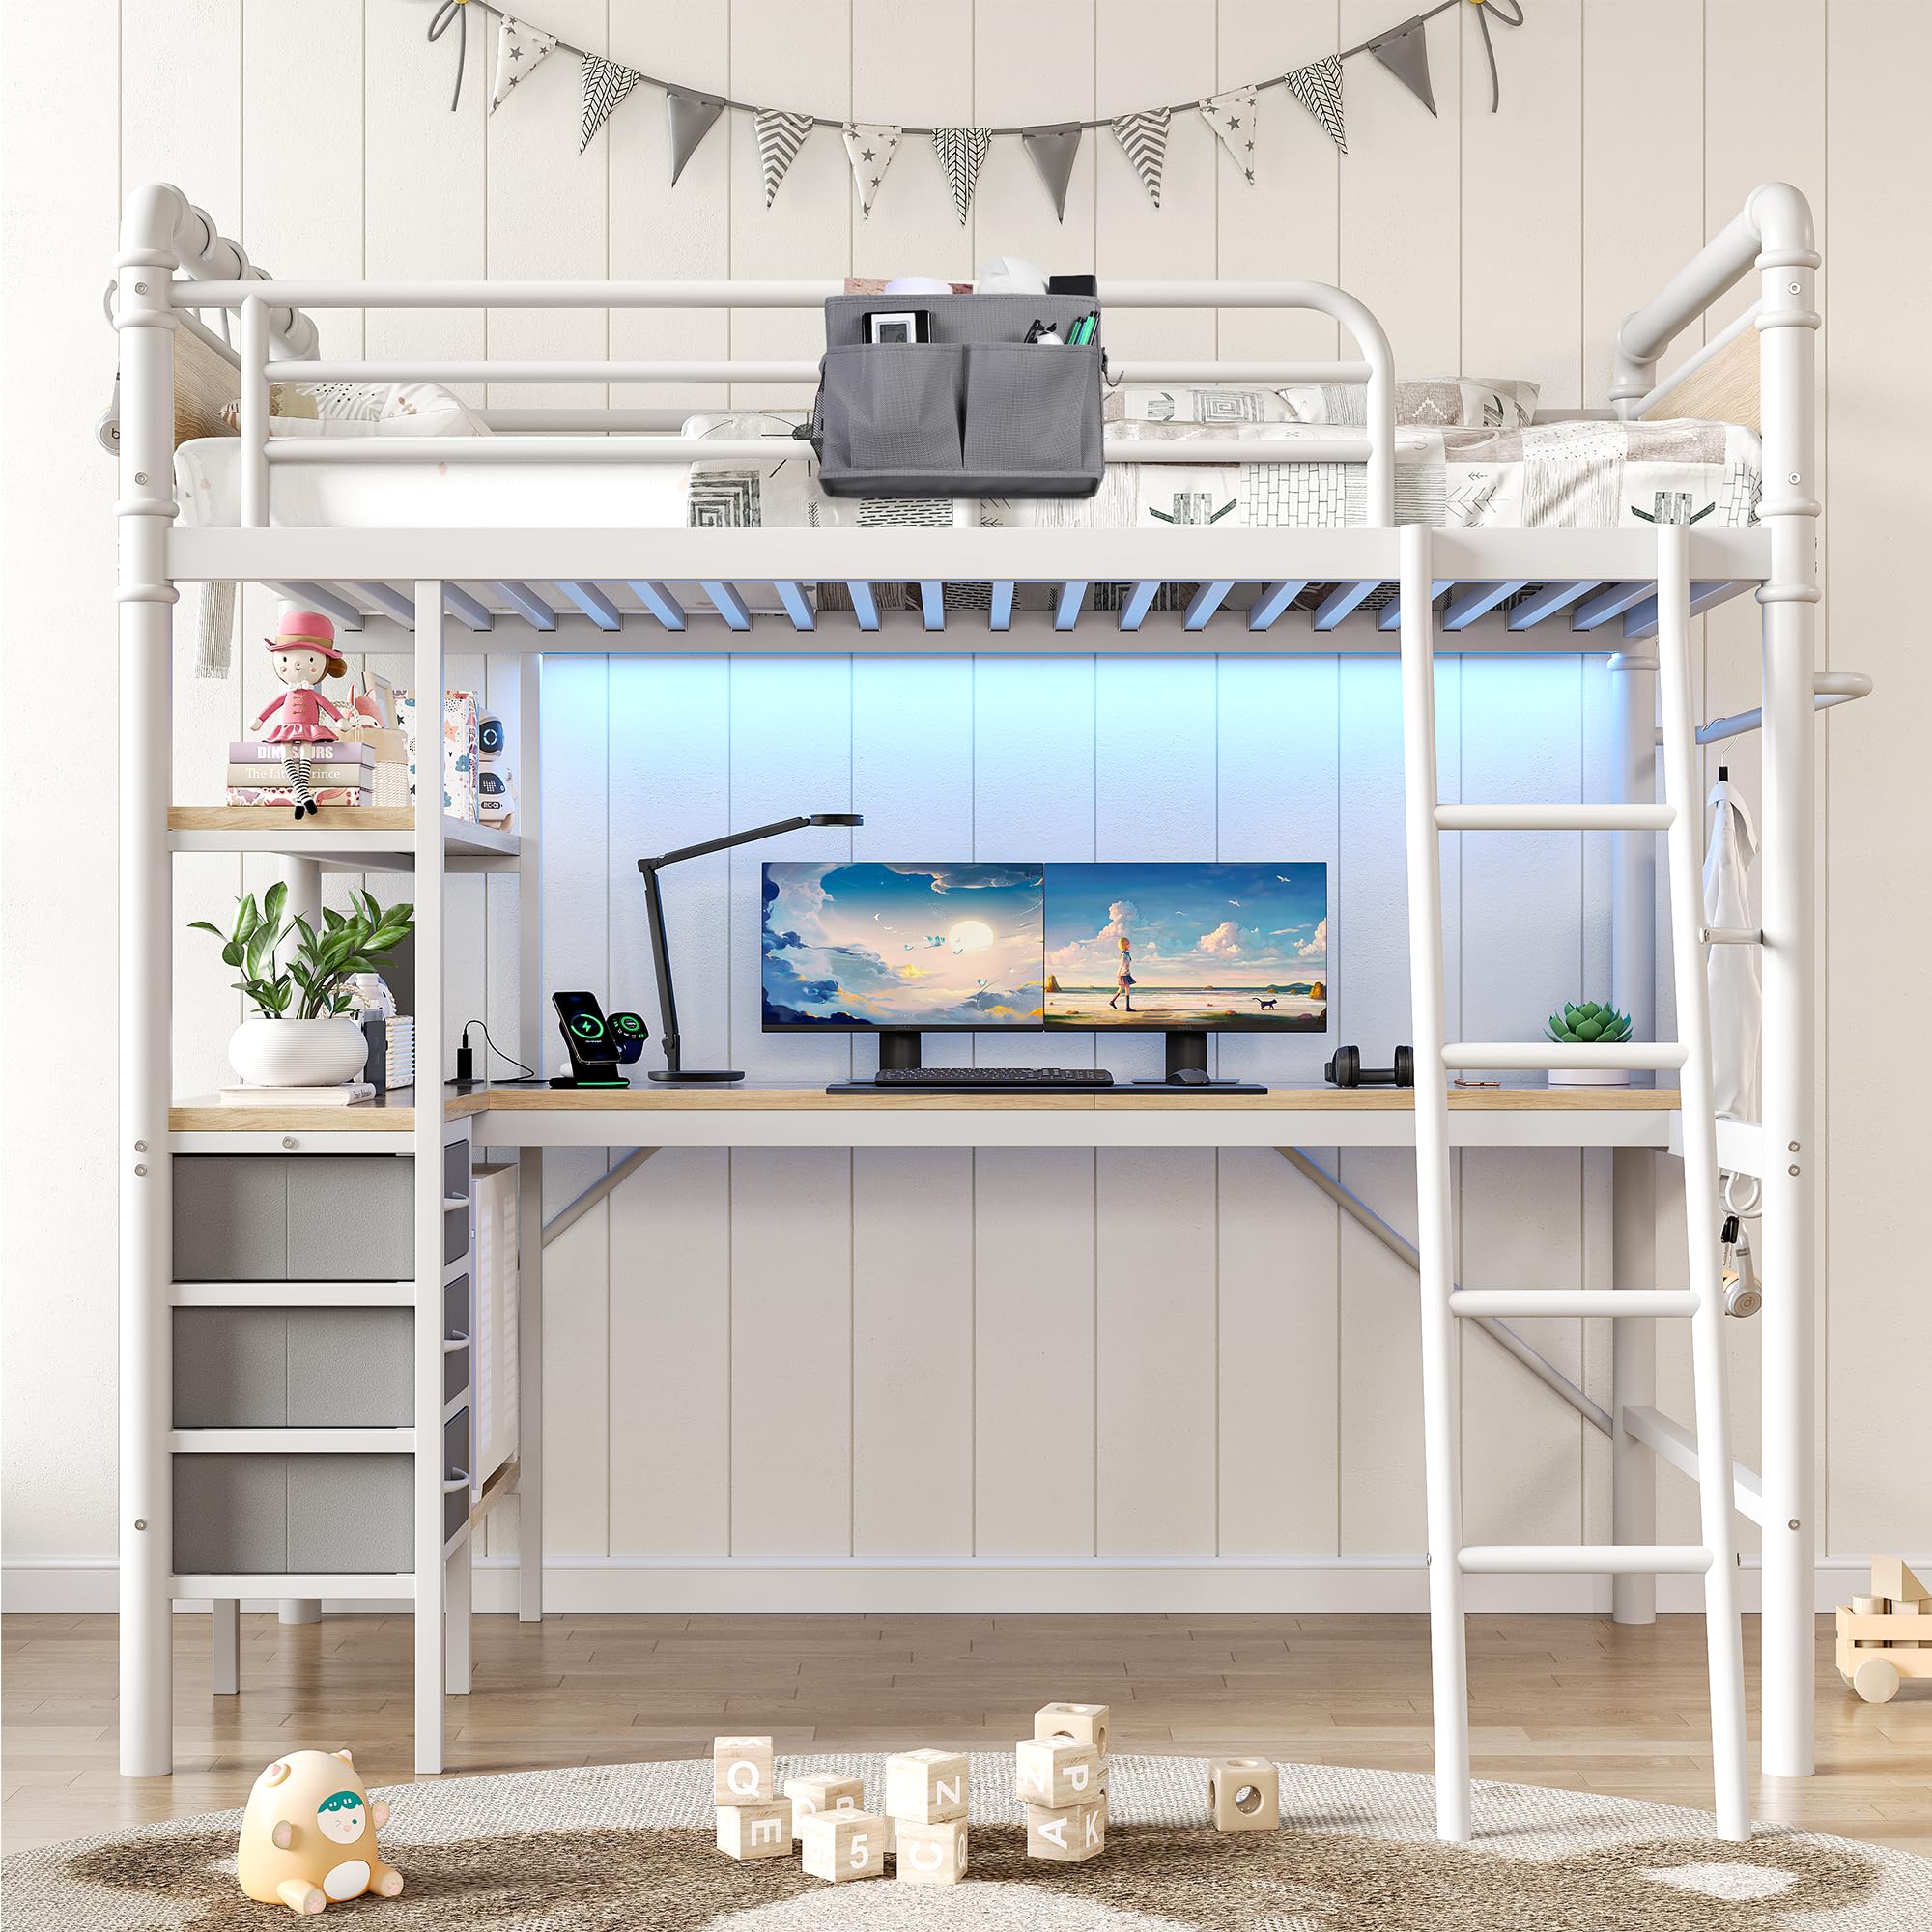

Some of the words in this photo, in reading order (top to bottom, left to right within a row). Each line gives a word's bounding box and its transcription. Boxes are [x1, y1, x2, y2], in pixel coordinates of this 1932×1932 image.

[257, 746, 333, 759] DINSRS
[246, 768, 267, 779] The
[312, 769, 340, 779] rince
[727, 1760, 760, 1797] Q
[1063, 1764, 1089, 1791] P
[751, 1818, 781, 1847] E
[1037, 1816, 1067, 1850] A
[1085, 1810, 1099, 1848] K
[849, 1834, 869, 1869] 5
